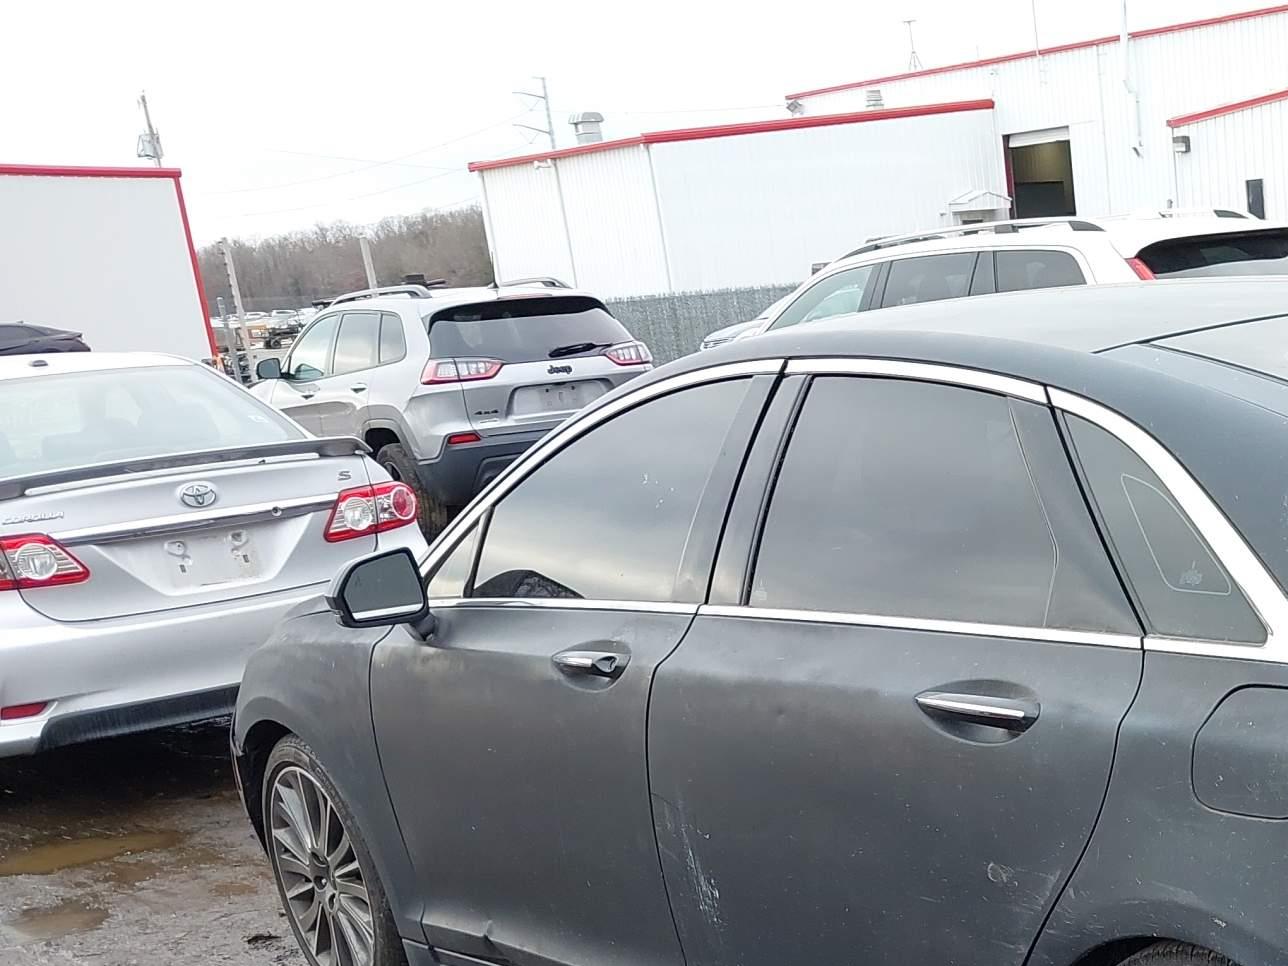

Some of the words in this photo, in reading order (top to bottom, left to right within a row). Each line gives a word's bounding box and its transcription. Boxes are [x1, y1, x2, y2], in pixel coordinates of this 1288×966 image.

[547, 364, 573, 375] Jeep
[337, 470, 352, 482] S
[2, 511, 65, 526] COROLLA
